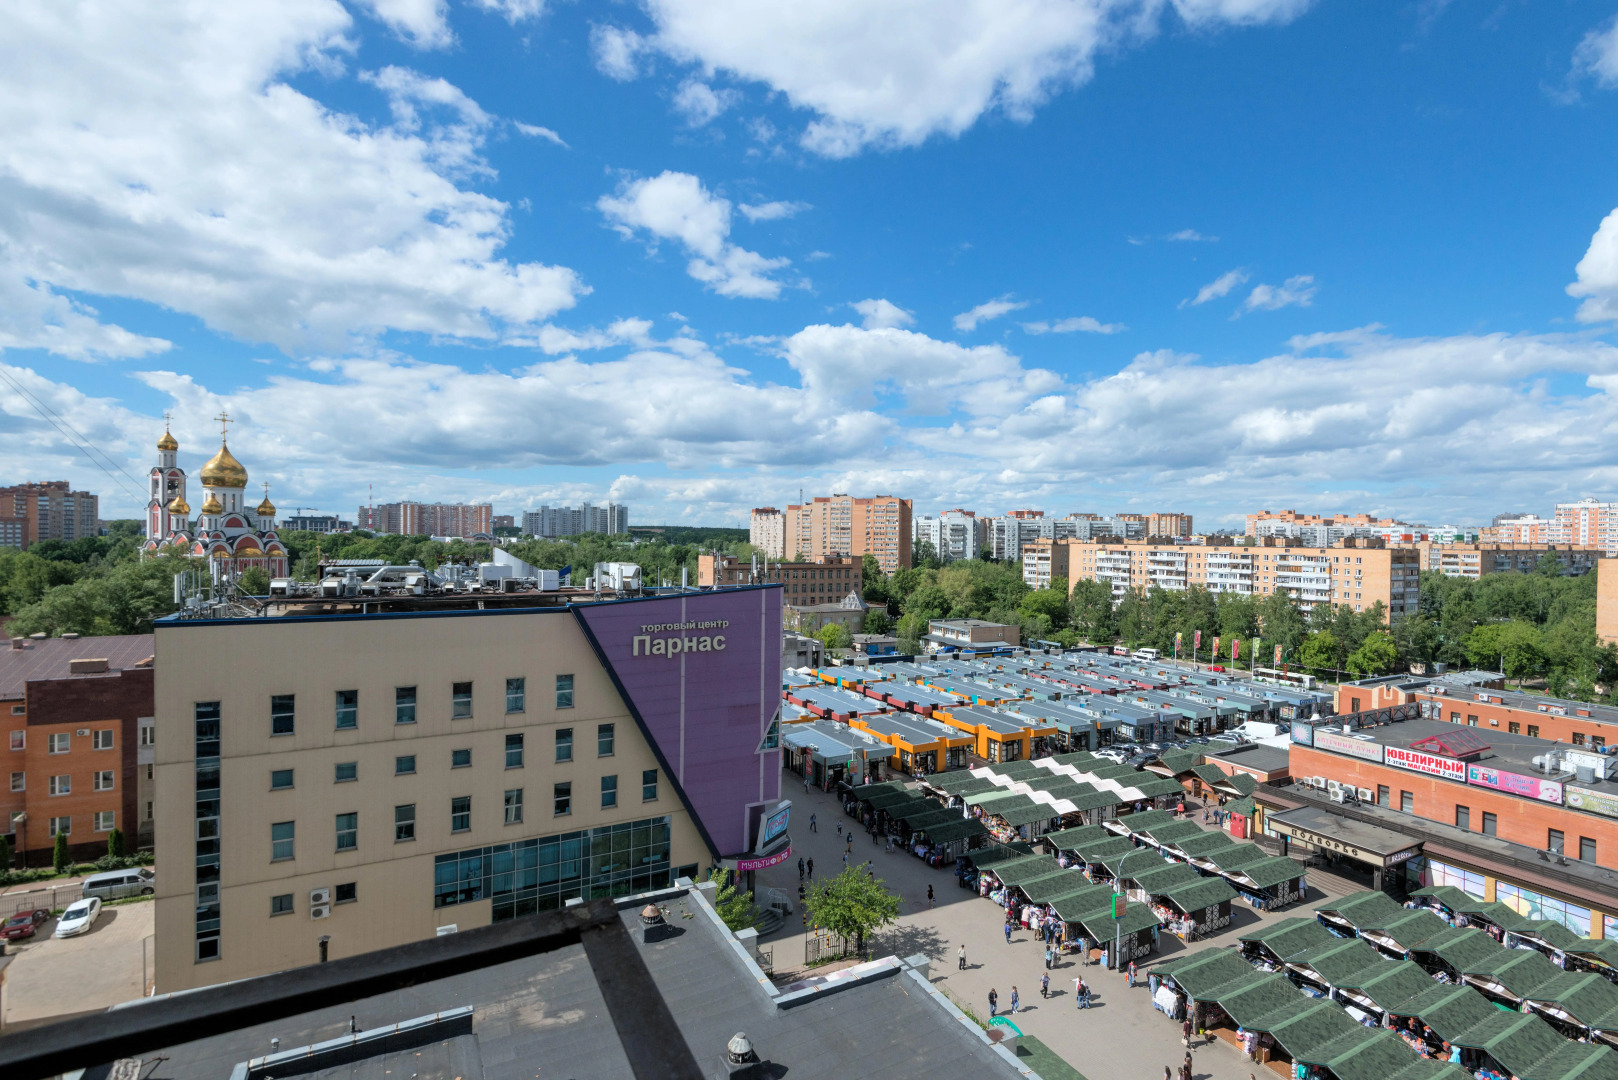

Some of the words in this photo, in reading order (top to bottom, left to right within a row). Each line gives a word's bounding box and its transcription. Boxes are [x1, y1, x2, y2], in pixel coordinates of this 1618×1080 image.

[641, 620, 695, 633] торговый
[697, 620, 729, 630] центр
[633, 635, 726, 659] Парнас
[1387, 748, 1464, 774] ЮВЕЛИРНЫЙ
[1407, 762, 1441, 775] МАГАЗИН
[741, 851, 788, 870] МУЛЬТИФОТО
